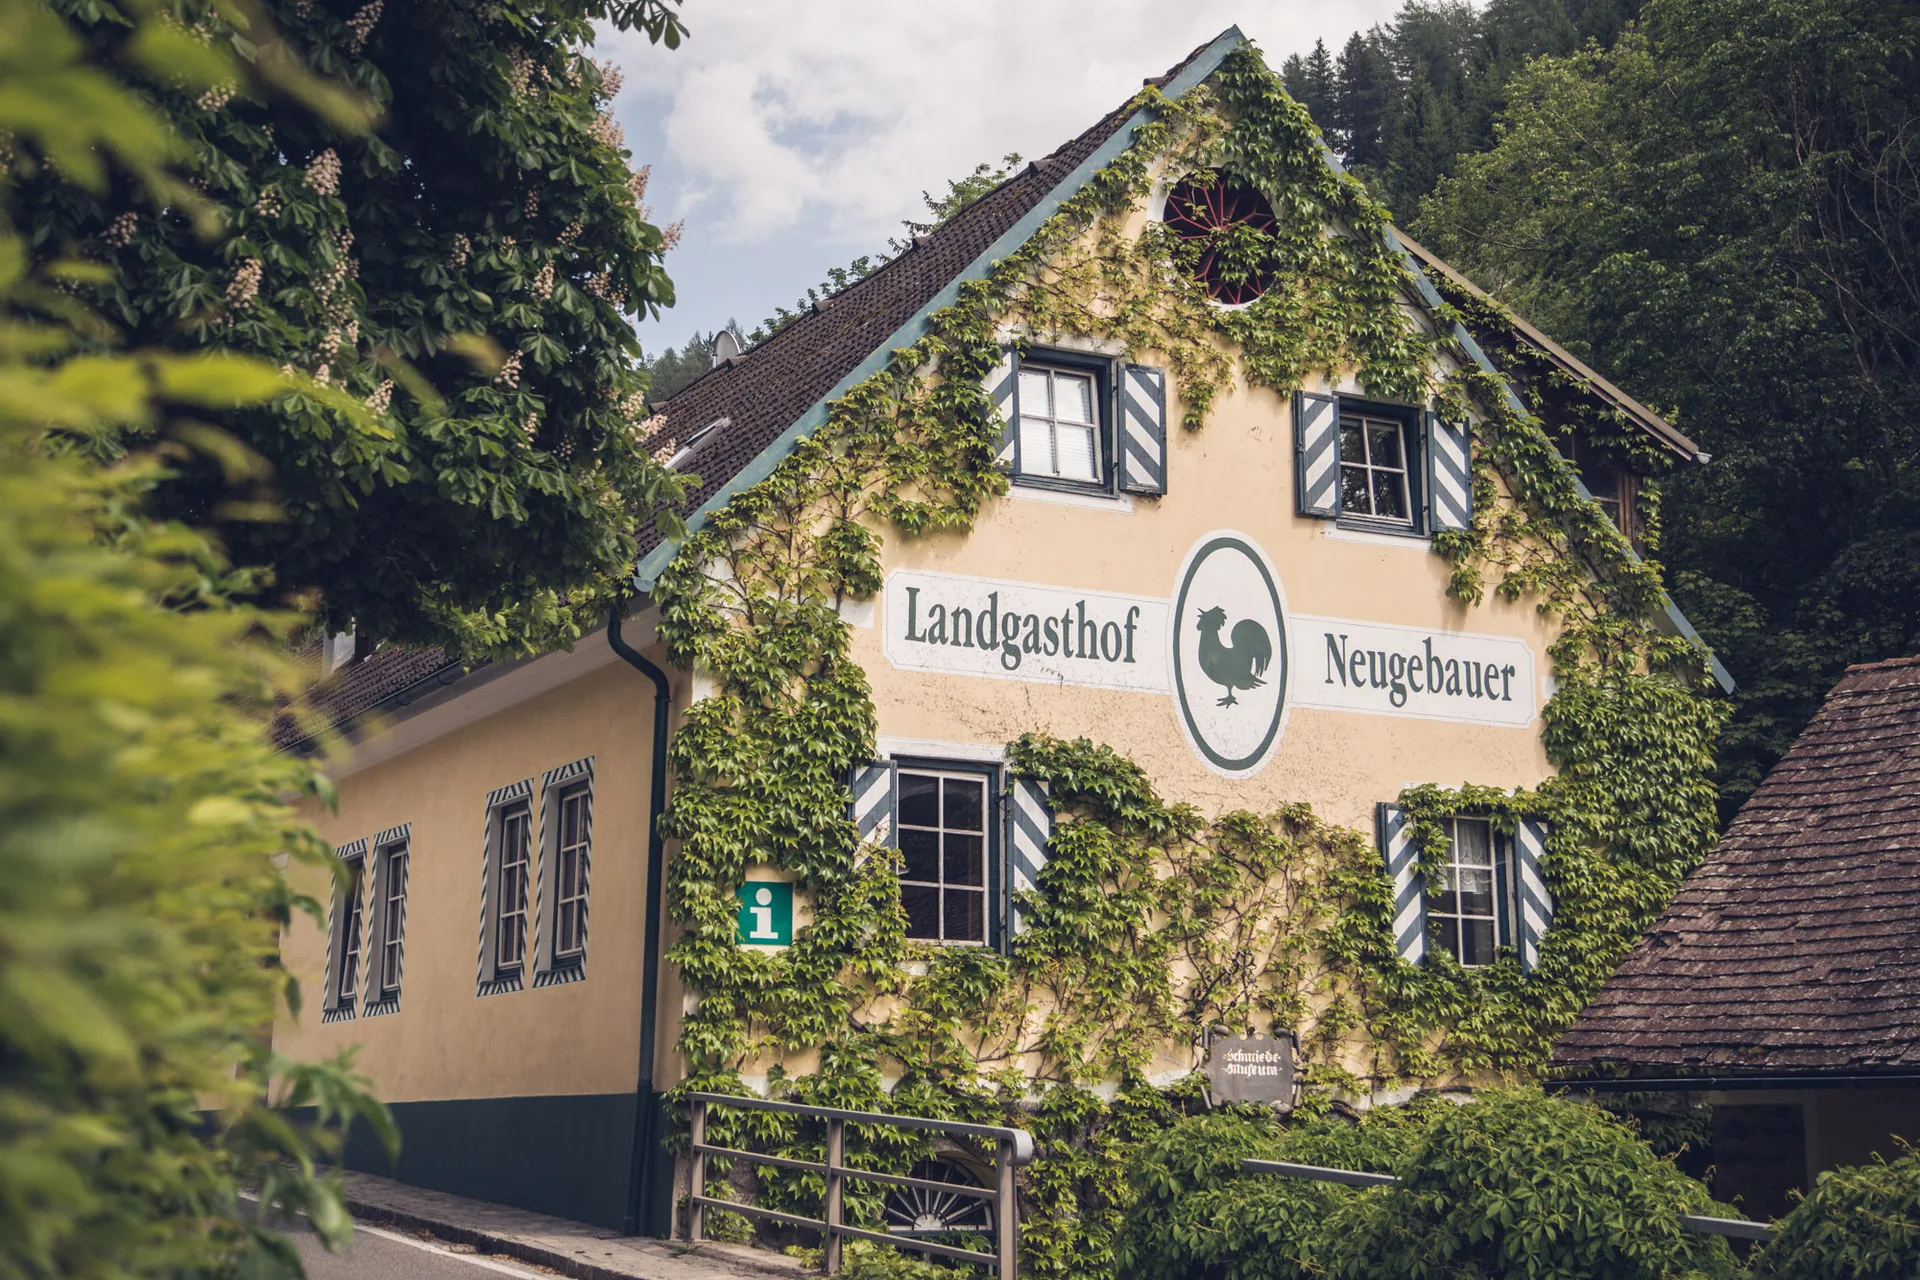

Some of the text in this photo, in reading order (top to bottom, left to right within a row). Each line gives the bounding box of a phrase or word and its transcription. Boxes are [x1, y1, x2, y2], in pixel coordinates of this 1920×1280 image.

[905, 587, 1515, 708] Landgasthof Neugebauer
[750, 888, 778, 939] i
